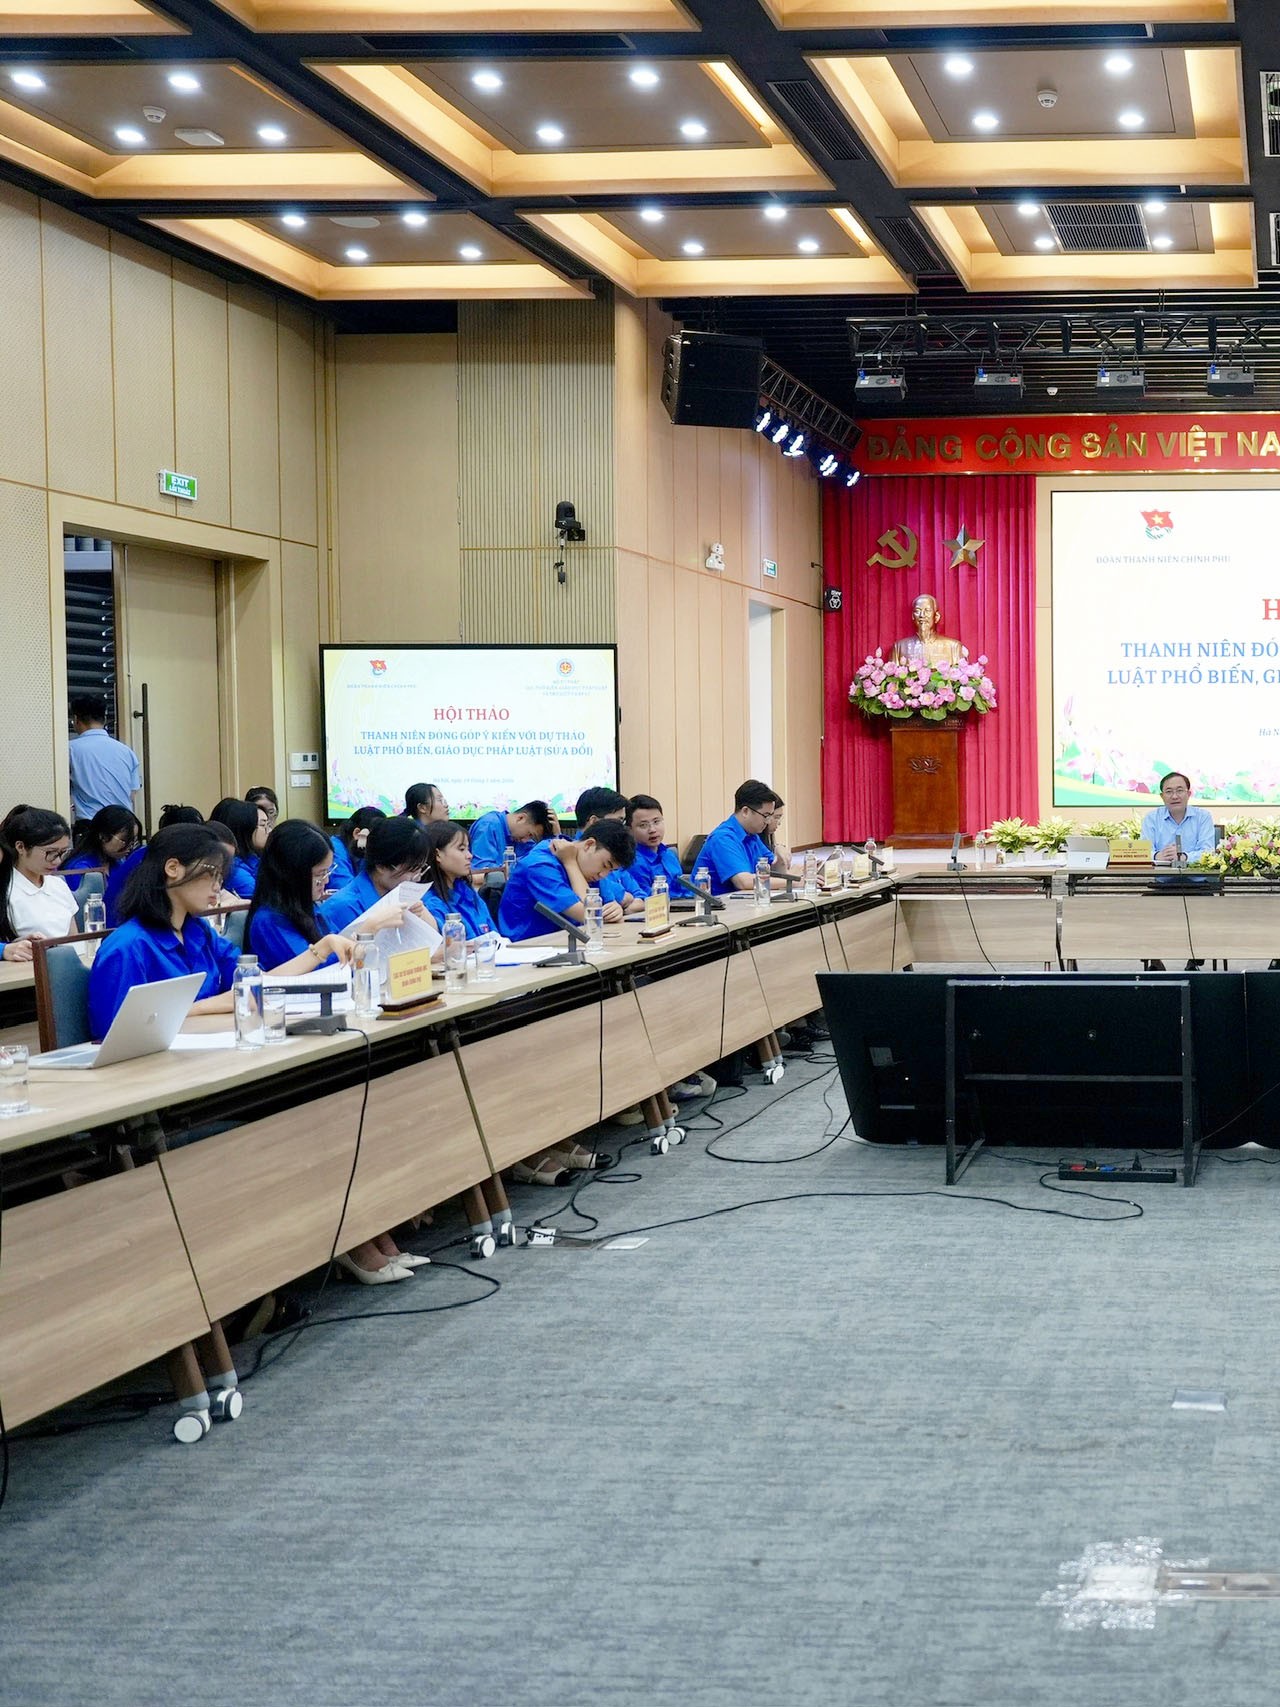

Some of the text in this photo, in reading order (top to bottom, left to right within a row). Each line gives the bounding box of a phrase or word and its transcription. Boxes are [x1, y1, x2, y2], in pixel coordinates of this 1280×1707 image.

[868, 426, 962, 462] ĐẢNG
[975, 427, 1071, 465] CỘNG
[1081, 423, 1147, 458] SẢN
[1156, 424, 1228, 463] VIỆT
[1124, 554, 1155, 564] THANH
[1121, 642, 1192, 658] THANH
[1198, 638, 1246, 657] NIÊN
[1107, 666, 1157, 688] LUẬT
[1162, 662, 1203, 684] PHỔ
[1208, 662, 1259, 686] BIẾN,
[434, 705, 510, 723] HỘI THẢO
[361, 731, 398, 740] THANH
[400, 729, 426, 740] NIÊN
[428, 729, 458, 740] ĐÓNG
[460, 729, 481, 740] GÓP
[492, 728, 516, 740] KIẾN
[518, 730, 536, 740] VỚI
[539, 731, 554, 742] DỰ
[556, 730, 585, 740] THẢO
[1259, 727, 1271, 738] Hà
[354, 744, 380, 756] LUẬT
[383, 742, 404, 755] PHỔ
[435, 745, 460, 755] GIÁO
[463, 746, 484, 757] DỤC
[486, 744, 514, 755] PHÁP
[516, 744, 542, 757] LUẬT
